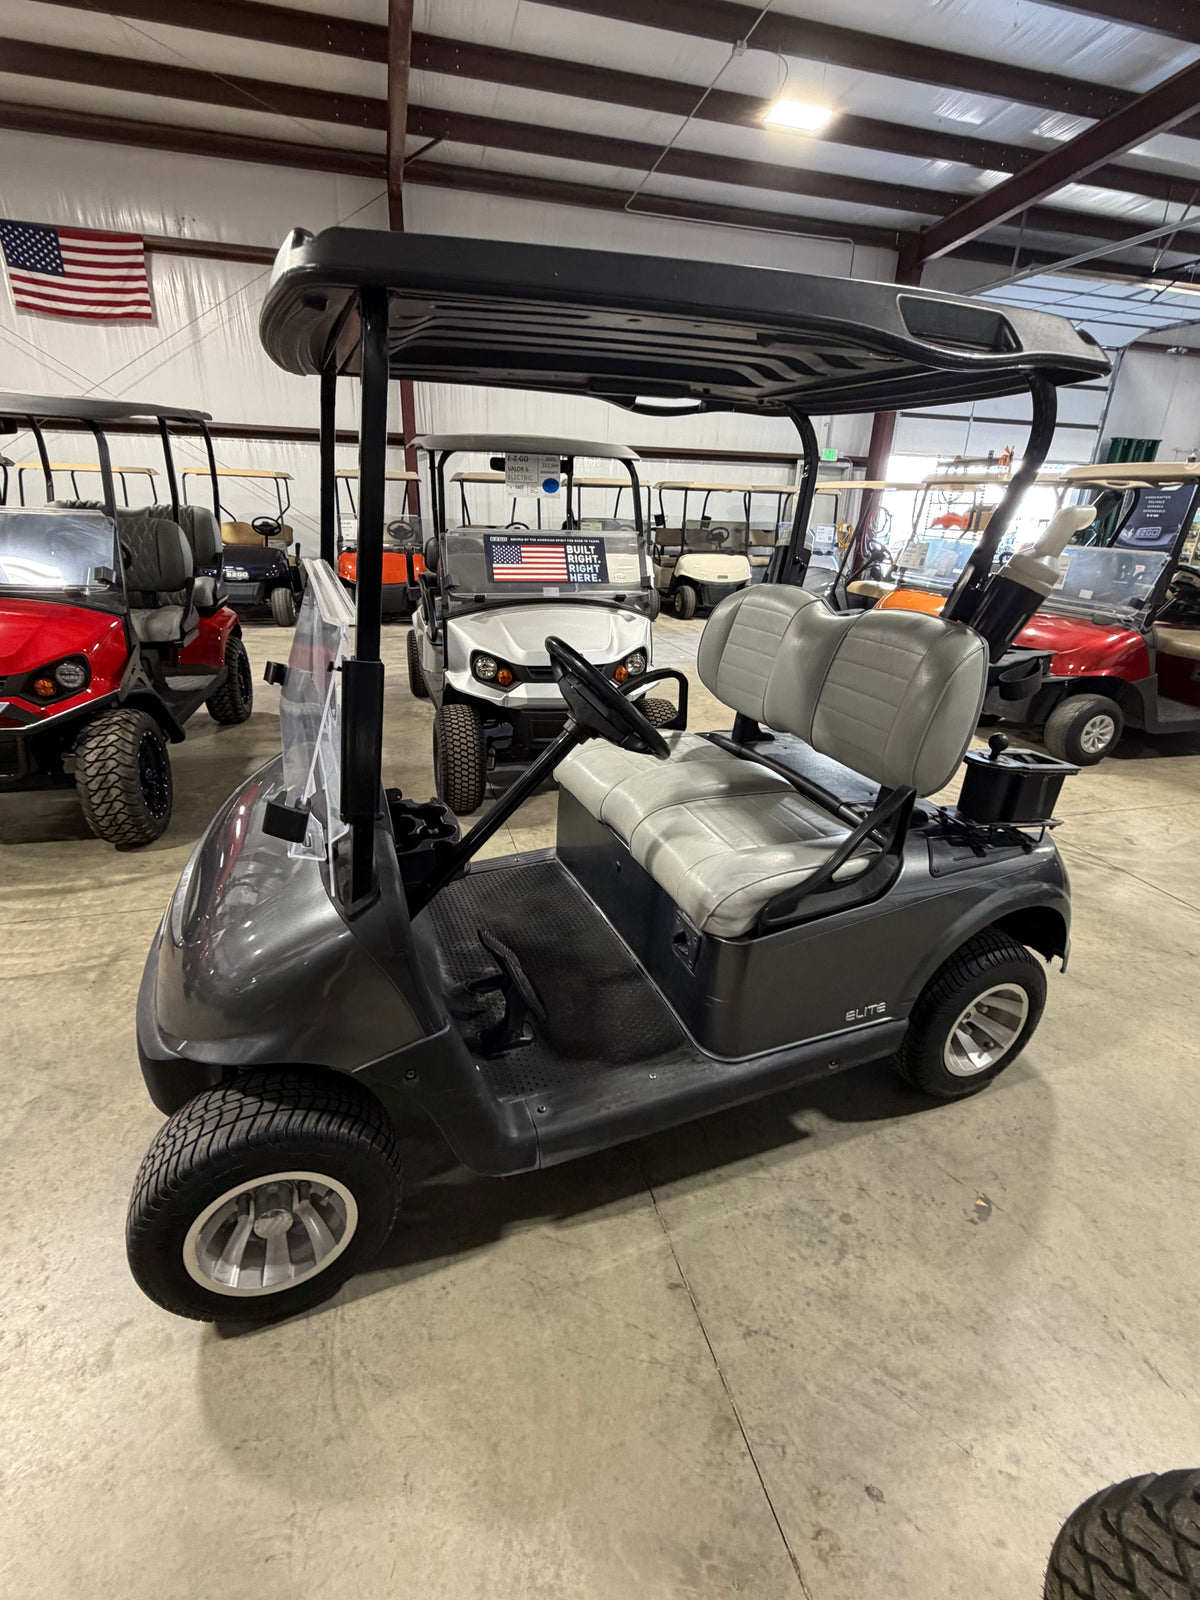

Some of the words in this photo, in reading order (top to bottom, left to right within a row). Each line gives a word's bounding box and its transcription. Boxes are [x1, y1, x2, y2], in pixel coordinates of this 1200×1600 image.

[566, 545, 595, 554] BUILT
[567, 554, 601, 564] RIGHT.
[568, 564, 600, 573] RIGHT
[569, 573, 602, 582] HERE.
[845, 1002, 886, 1021] ELITE
